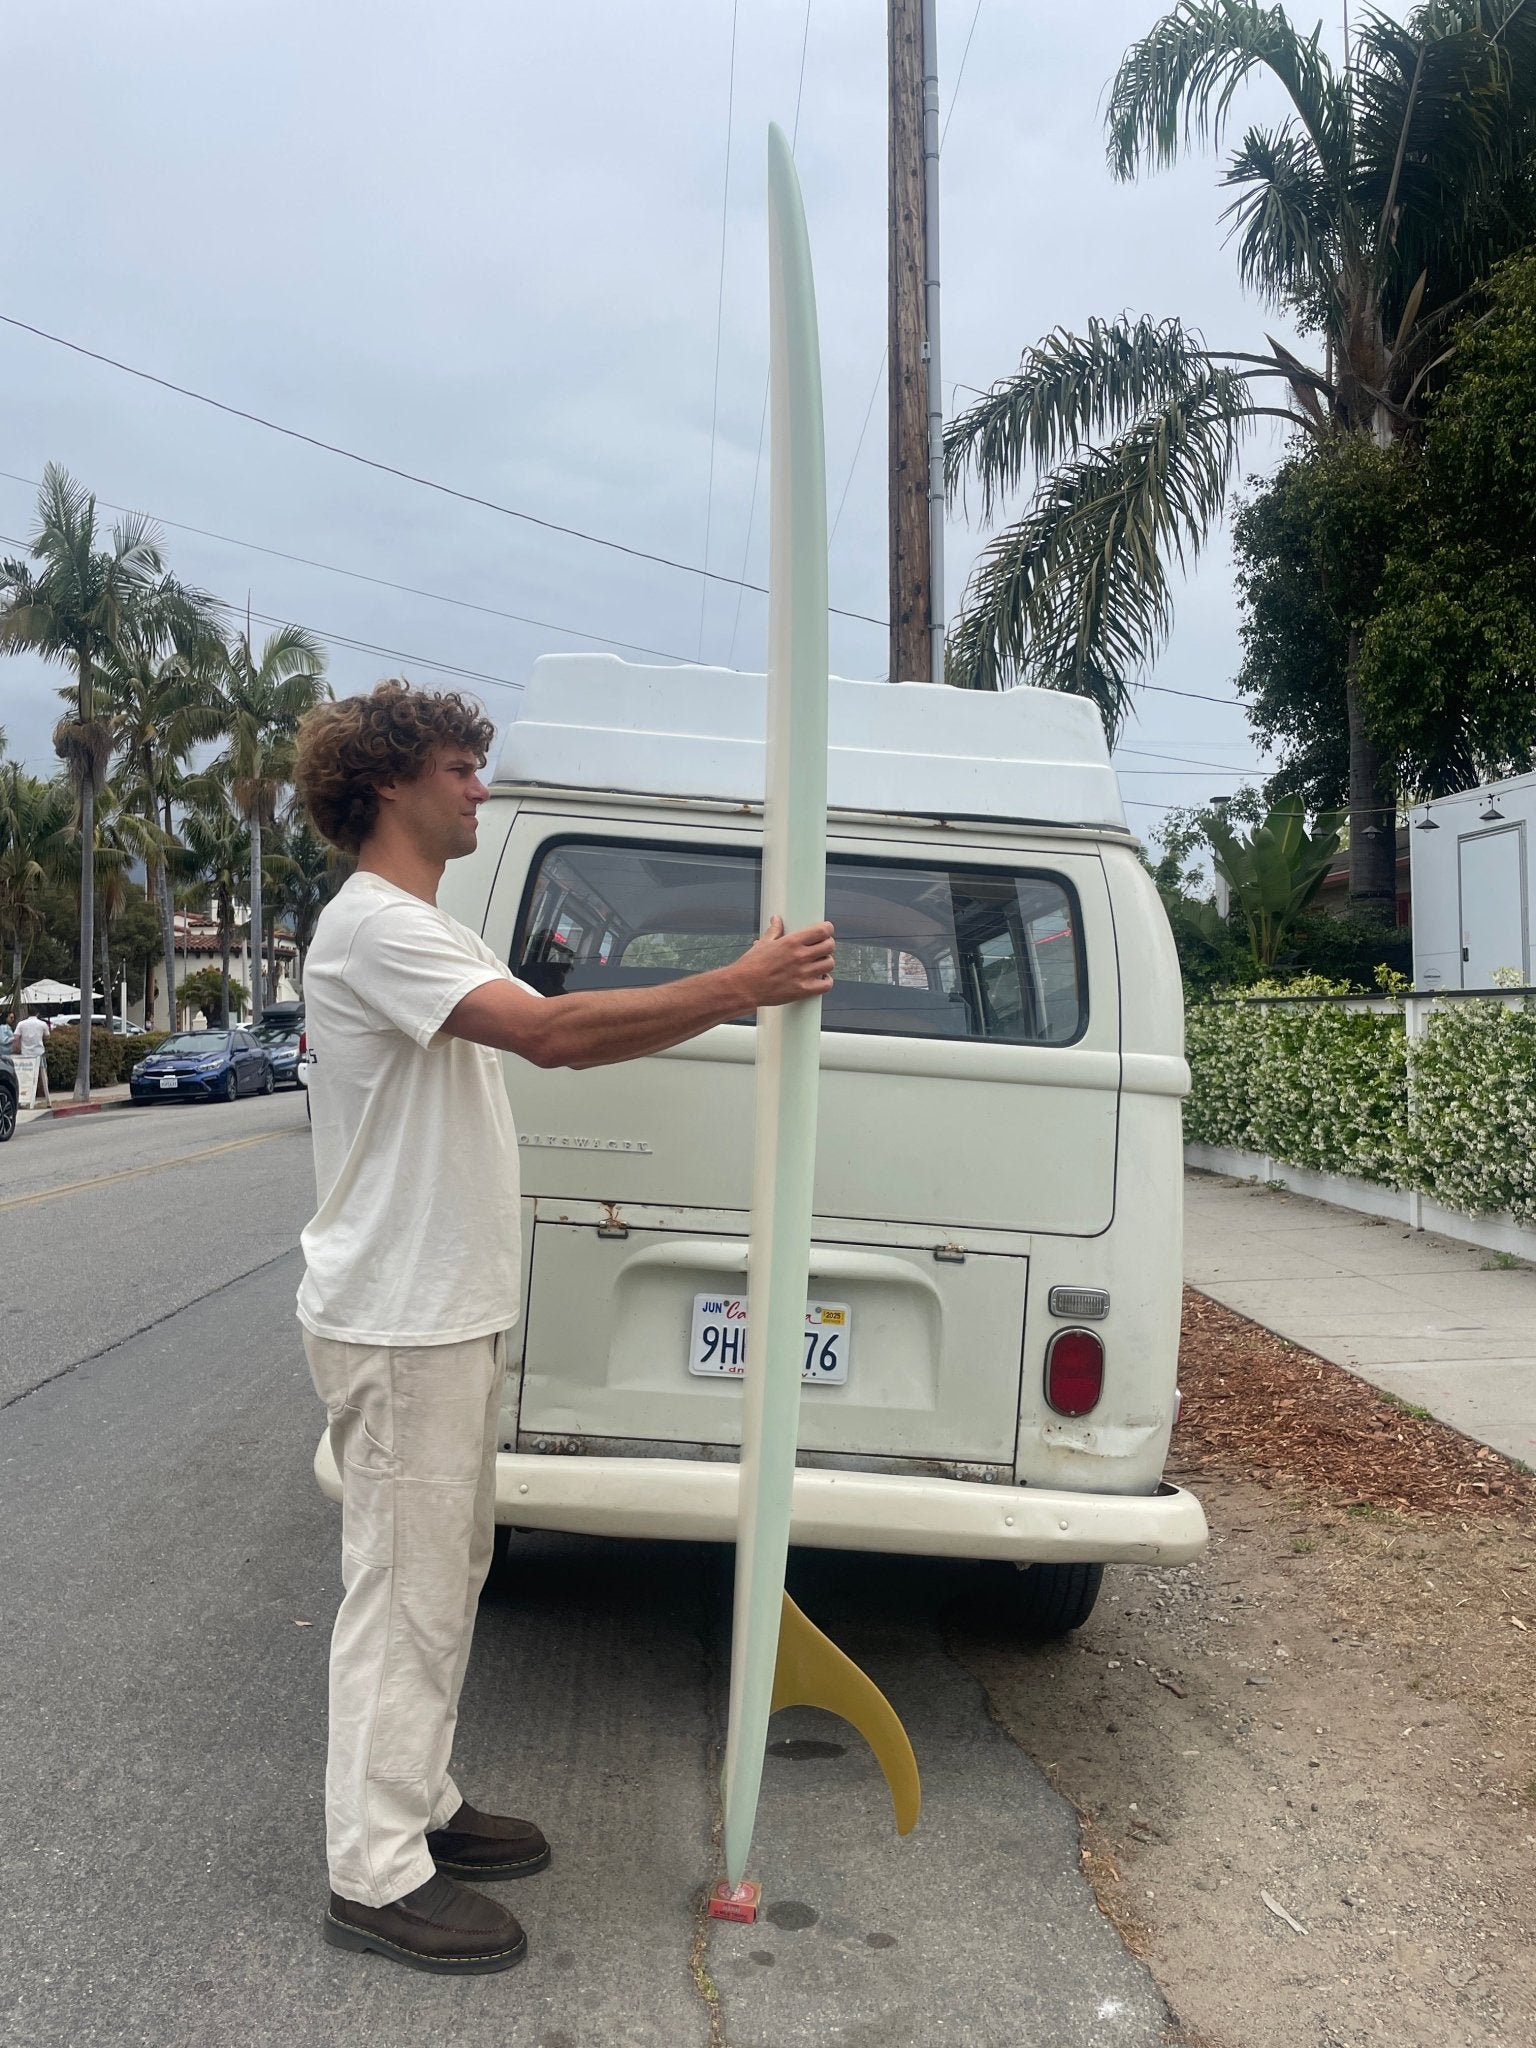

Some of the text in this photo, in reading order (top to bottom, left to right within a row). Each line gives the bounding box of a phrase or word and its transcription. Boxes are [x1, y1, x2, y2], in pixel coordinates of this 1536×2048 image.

[519, 1133, 650, 1151] OLKSWAGEN
[702, 1301, 722, 1313] JUN
[825, 1311, 841, 1320] 2025
